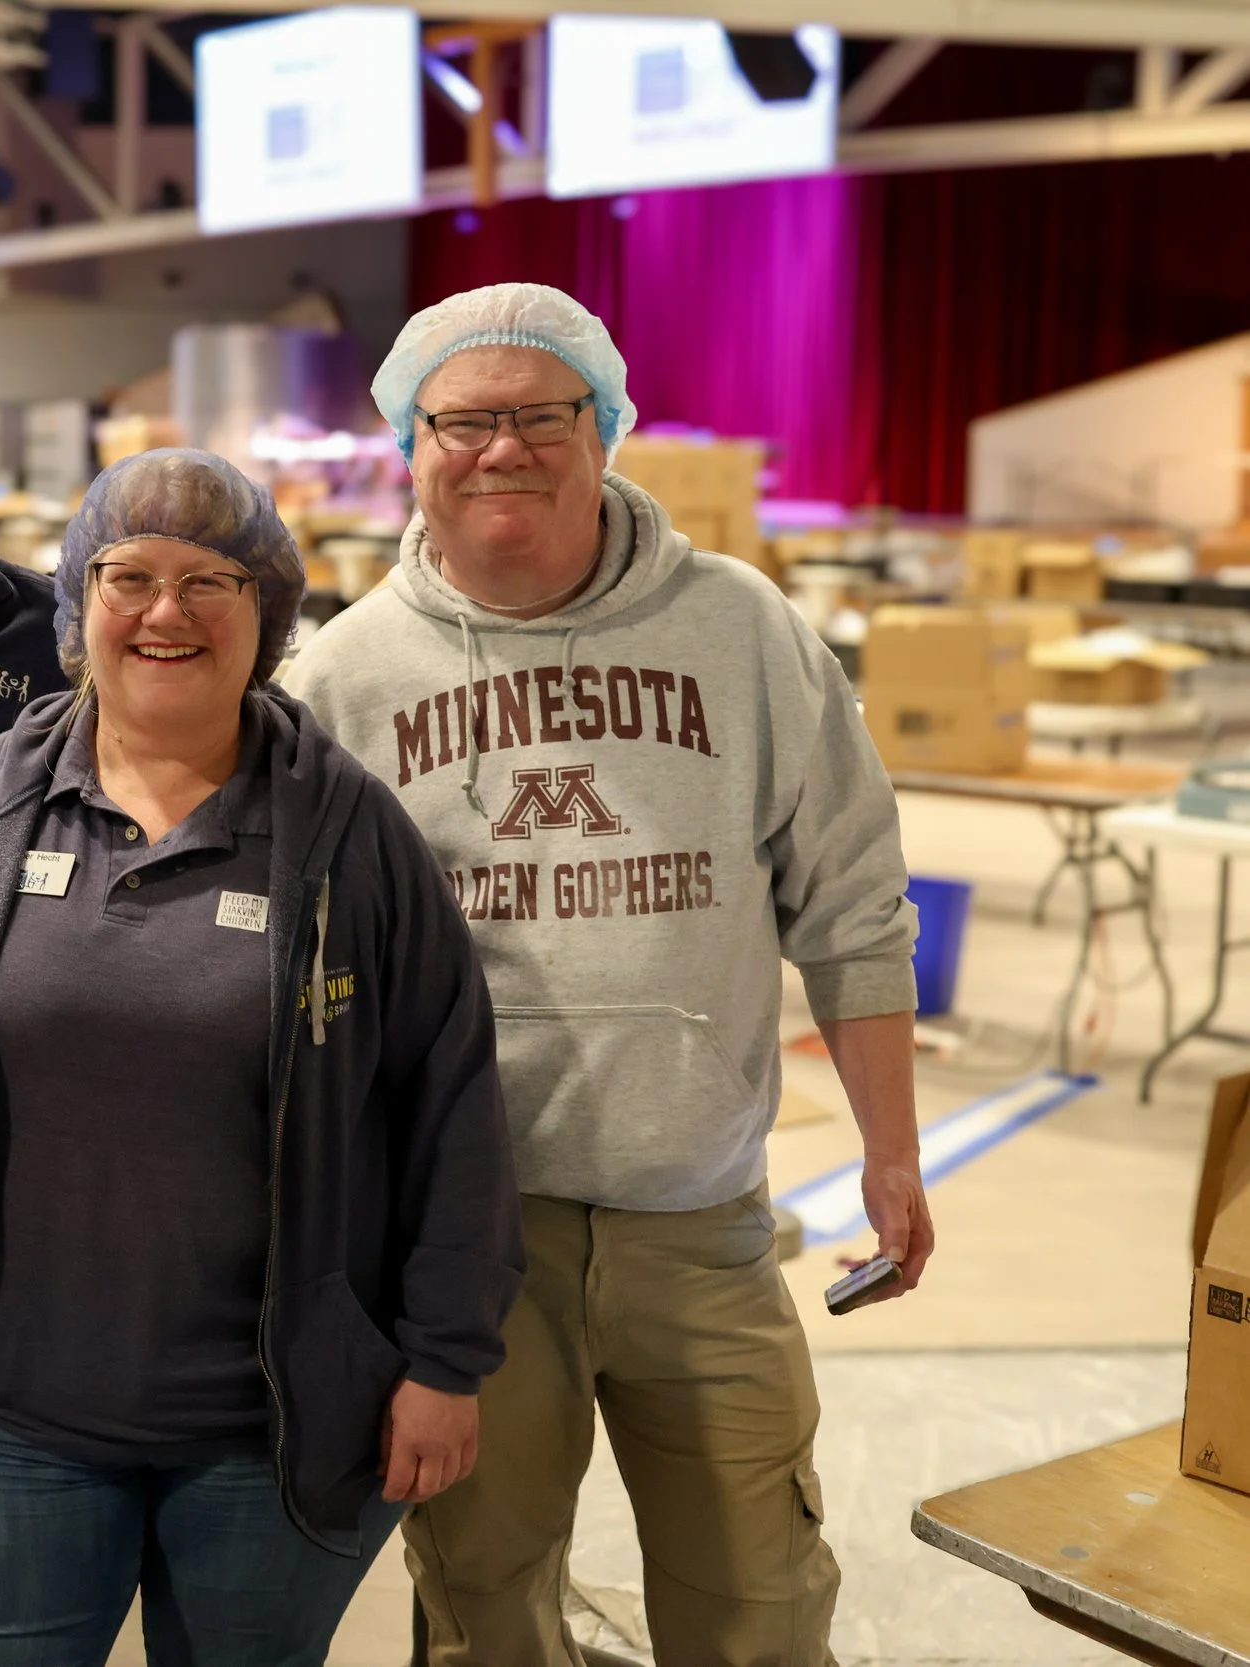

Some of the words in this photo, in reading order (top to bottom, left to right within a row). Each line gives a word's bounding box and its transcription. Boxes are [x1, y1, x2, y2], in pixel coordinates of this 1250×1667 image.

[393, 664, 712, 788] MINNESOTA
[491, 763, 622, 841] M
[224, 894, 249, 906] FEED
[251, 897, 263, 909] MY
[553, 850, 713, 920] GOPHERS
[220, 914, 261, 929] CHILDREN
[222, 904, 262, 919] STARVING
